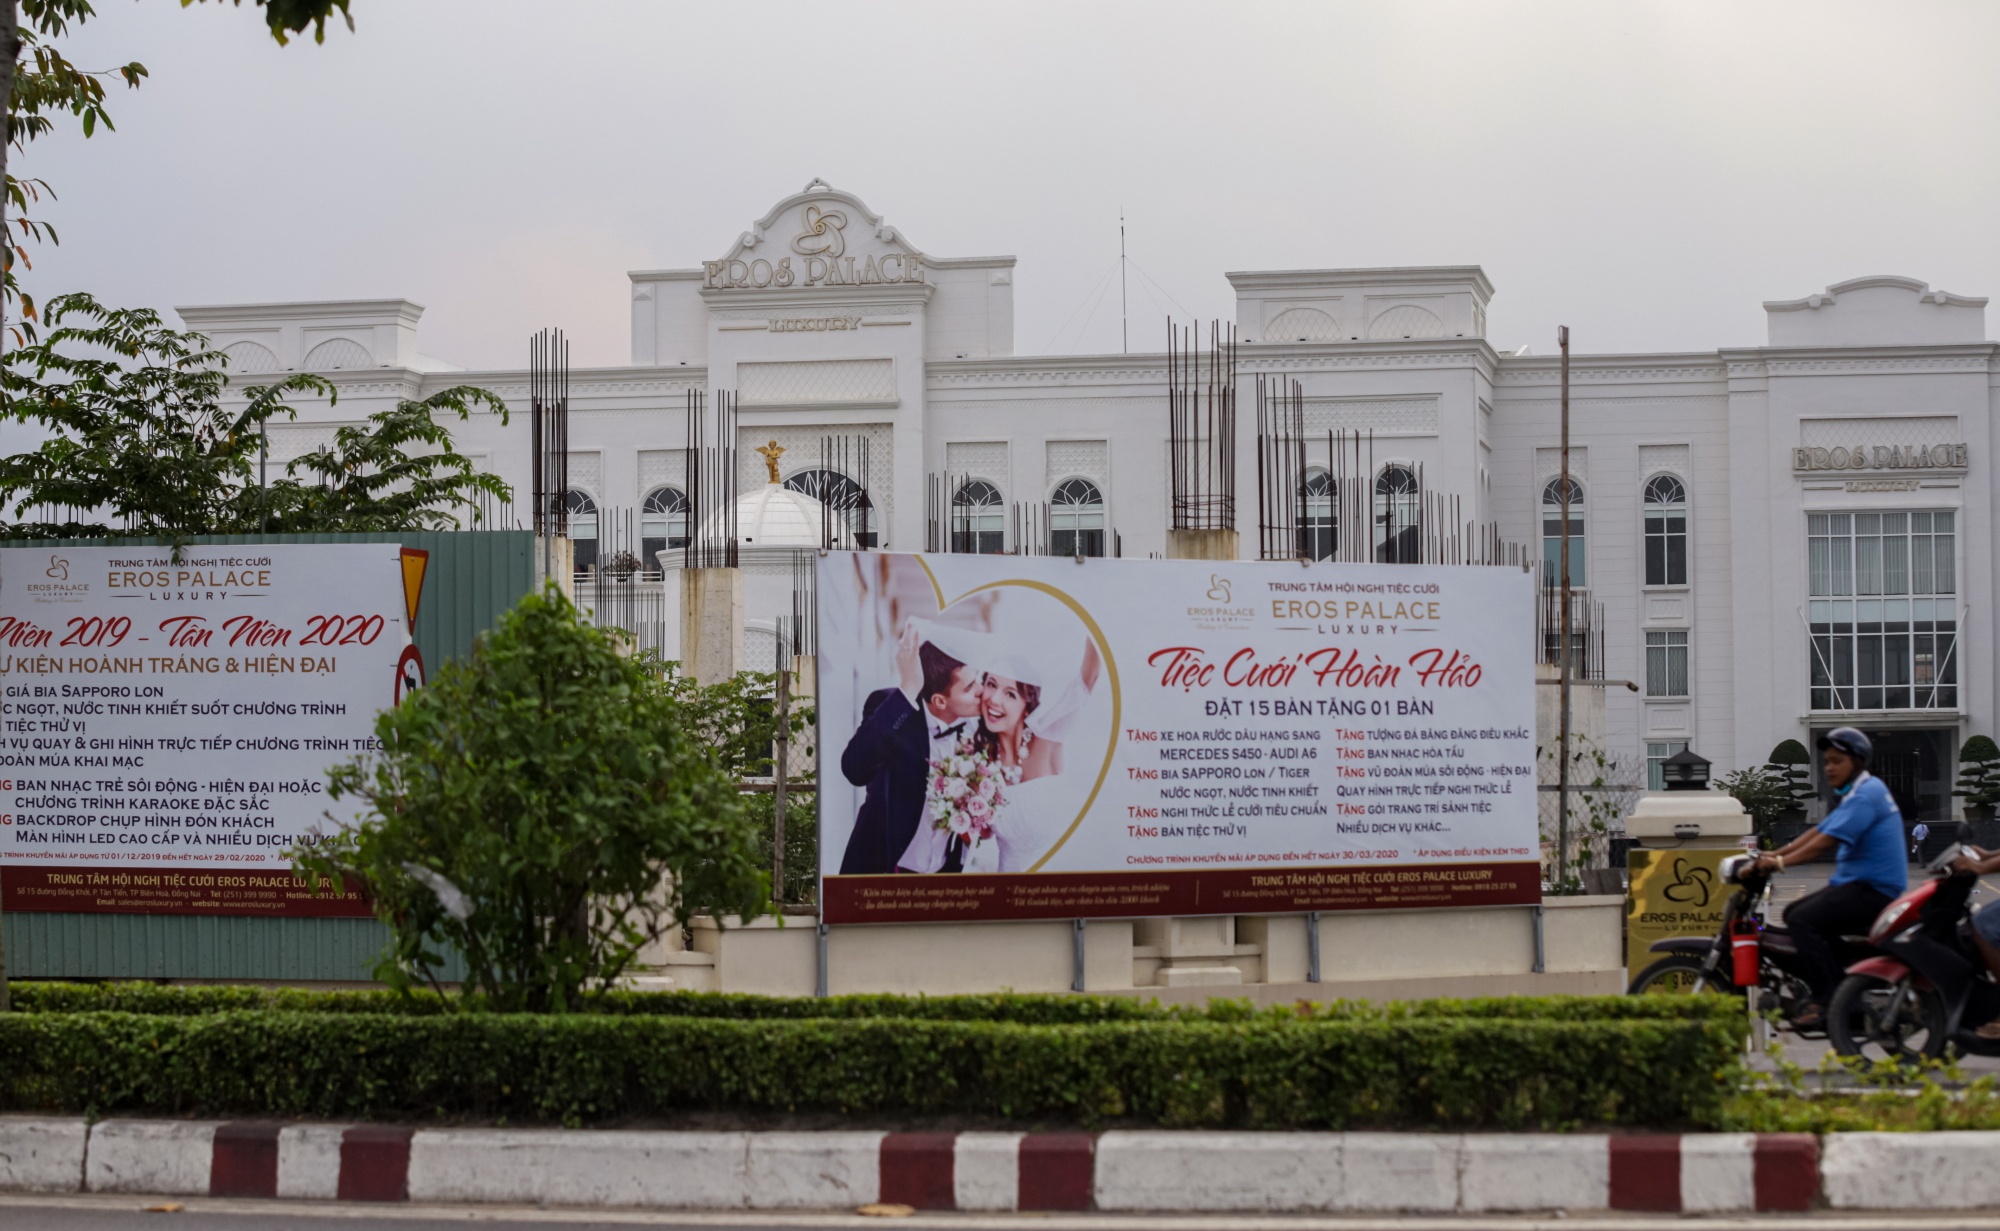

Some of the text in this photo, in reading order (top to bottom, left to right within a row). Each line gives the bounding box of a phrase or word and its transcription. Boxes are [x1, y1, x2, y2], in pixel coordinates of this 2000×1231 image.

[702, 253, 925, 289] EROS PALACE
[768, 317, 862, 332] LUXURY
[1792, 443, 1968, 471] EROS PALACE
[1845, 480, 1920, 493] LUXURY
[108, 556, 271, 568] TRUNG TÂM NGHỊ TIỆC CƯỚI
[108, 570, 271, 588] EROS PALACE
[1268, 581, 1440, 594] TRUNG TÂM HỘI NGHỊ CƯỚI
[150, 591, 228, 601] LUXURY
[1216, 608, 1255, 616] PALACE
[1272, 600, 1441, 620] EROS PALACE
[59, 614, 385, 648] 2019 Tân Niên 2020
[1318, 625, 1398, 635] LUXURY
[16, 653, 336, 677] KIỆN HOÀNH TRÁNG HIỆN ĐẠI
[1147, 647, 1482, 693] Tiệc Cưới Hoàn Hảo
[6, 683, 163, 697] GIÁ BIA SAPPORO LON
[16, 704, 59, 717] NGỌT,
[64, 701, 103, 715] NƯỚC
[107, 704, 140, 714] TINH
[145, 699, 187, 714] KHIẾT
[191, 699, 229, 715] SUỐT
[233, 701, 296, 715] CHƯƠNG
[301, 701, 345, 714] TRÌNH
[1205, 697, 1434, 719] ĐẶT 15 BÀN TẶNG 01 BÀN
[5, 717, 85, 735] TIỆC THỬ VỊ
[1160, 729, 1321, 741] XE HOA RƯỚC SANG
[10, 734, 348, 752] VỤ QUAY GHI HÌNH TRỰC TIẾP CHƯƠNG TRÌNH
[1160, 747, 1317, 760] MERCEDES S450 AUDI A6
[1367, 749, 1420, 759] BAN NHẠC
[39, 753, 143, 769] MÚA KHAI MẠC
[1161, 766, 1310, 779] BIA SAPPORO LON TIGER
[17, 780, 46, 791] BAN
[51, 780, 91, 794] NHẠC
[95, 777, 123, 791] TRẺ
[127, 778, 150, 792] SÔI
[155, 778, 197, 795] ĐỘNG
[209, 778, 244, 795] HIỆN
[249, 782, 274, 796] ĐẠI
[279, 779, 321, 796] HOẶC
[1160, 783, 1318, 798] NƯỚC NƯỚC TINH KHIẾT
[1336, 785, 1471, 797] QUAY NGHI
[15, 793, 269, 812] CHƯƠNG TRÌNH KARAOKE ĐẶC SẮC
[1387, 804, 1422, 814] TRANG
[1161, 804, 1262, 818] NGHI CƯỚI
[17, 815, 96, 826] BACKDROP
[100, 815, 140, 829] CHỤP
[145, 813, 180, 827] HÌNH
[185, 813, 217, 827] ĐÓN
[222, 814, 274, 828] KHÁCH
[1186, 824, 1246, 838] TIỆC VỊ
[1371, 823, 1396, 834] DỊCH
[16, 829, 293, 849] MÀN HÌNH LED CAO CẤP VÀ NHIỀU DỊCH
[4, 851, 25, 859] TRÌNH
[194, 853, 212, 861] NGÀY
[214, 854, 266, 862] 29/02/2020
[1342, 850, 1399, 859] 30/03/2020
[47, 873, 289, 888] TRUNG TÂM HỘI NGHỊ TIỆC CƯỚI EROS PALACE
[1252, 870, 1493, 886] TRUNG EROS PALACE LUXURY
[27, 887, 35, 895] 15
[130, 889, 139, 897] TP
[190, 890, 201, 898] Nai
[258, 891, 277, 899] 9990
[223, 901, 286, 909] www.erosluxury.vn
[1640, 912, 1724, 922] EROS PALAC
